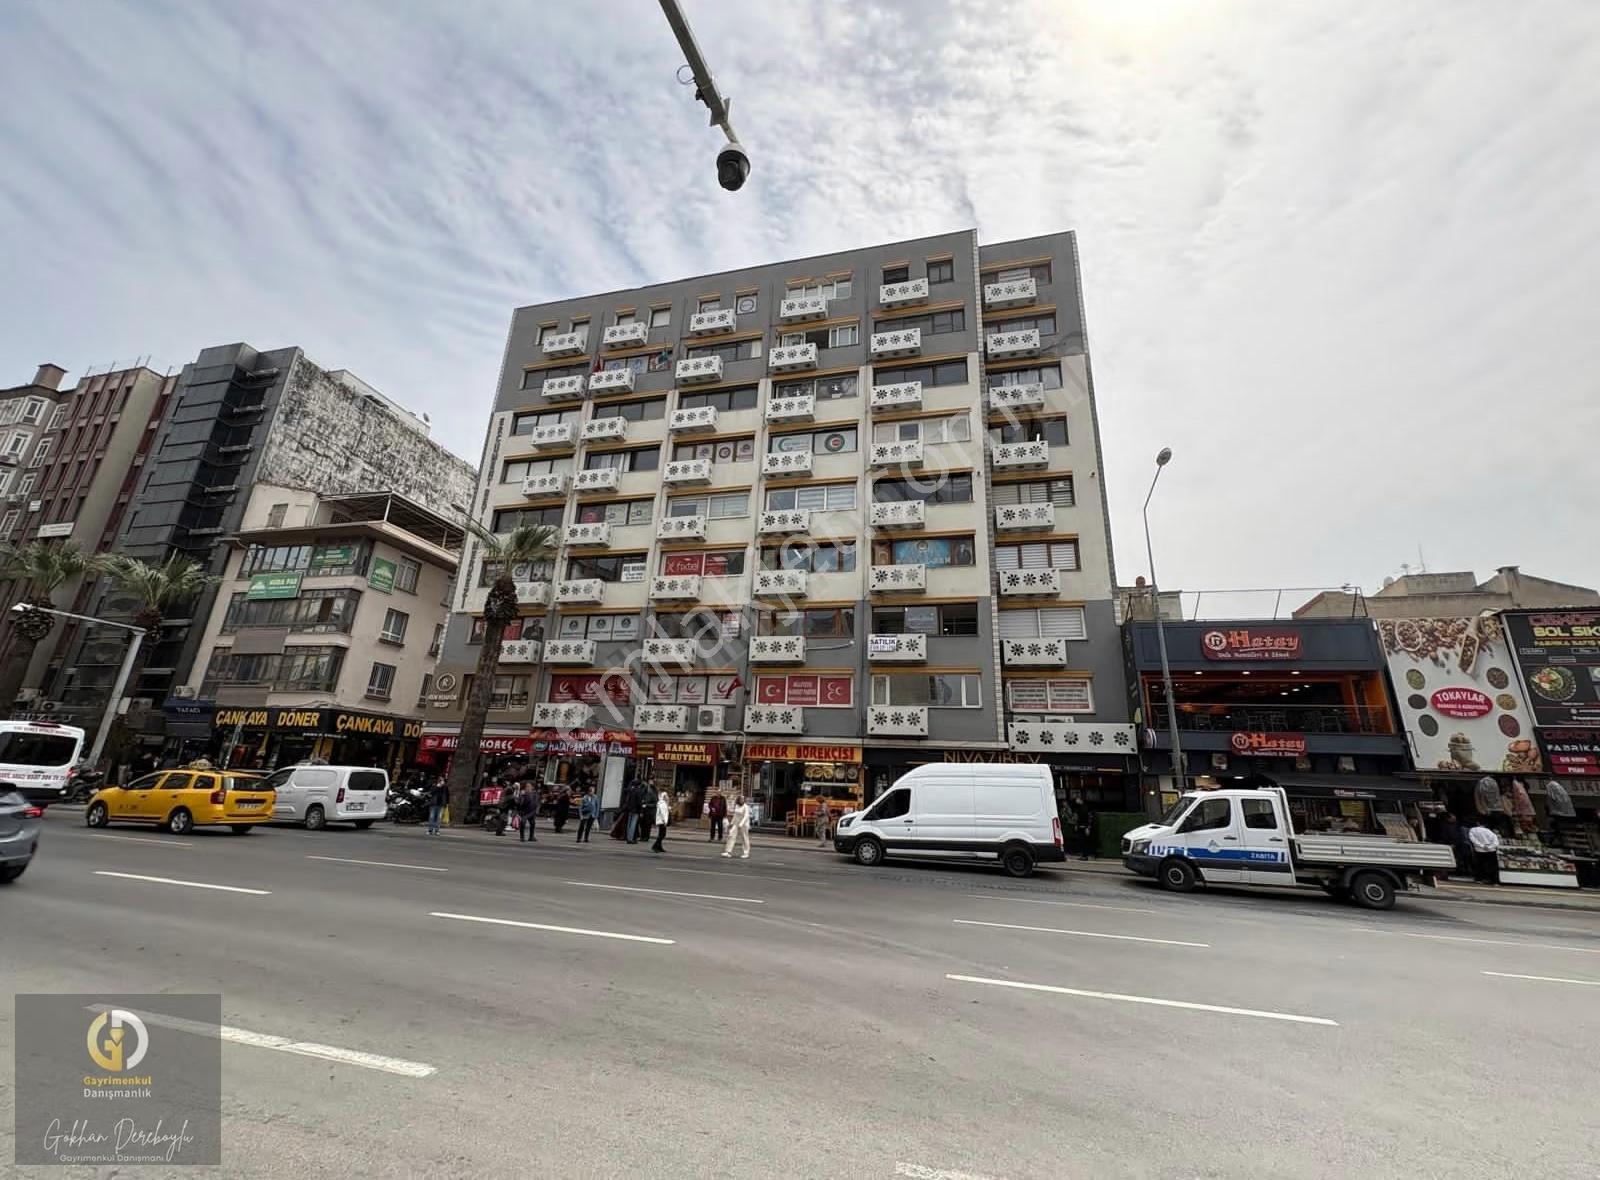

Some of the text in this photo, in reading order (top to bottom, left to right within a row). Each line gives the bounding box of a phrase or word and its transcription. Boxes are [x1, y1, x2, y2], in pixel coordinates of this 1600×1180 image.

[1533, 626, 1570, 637] BOL
[1229, 630, 1298, 651] Hatay
[1435, 691, 1486, 705] TOKAYLAR
[215, 708, 320, 728] ÇANKAYA DÖNER
[336, 714, 394, 735] ÇANKAYA
[664, 743, 706, 753] HARMAN
